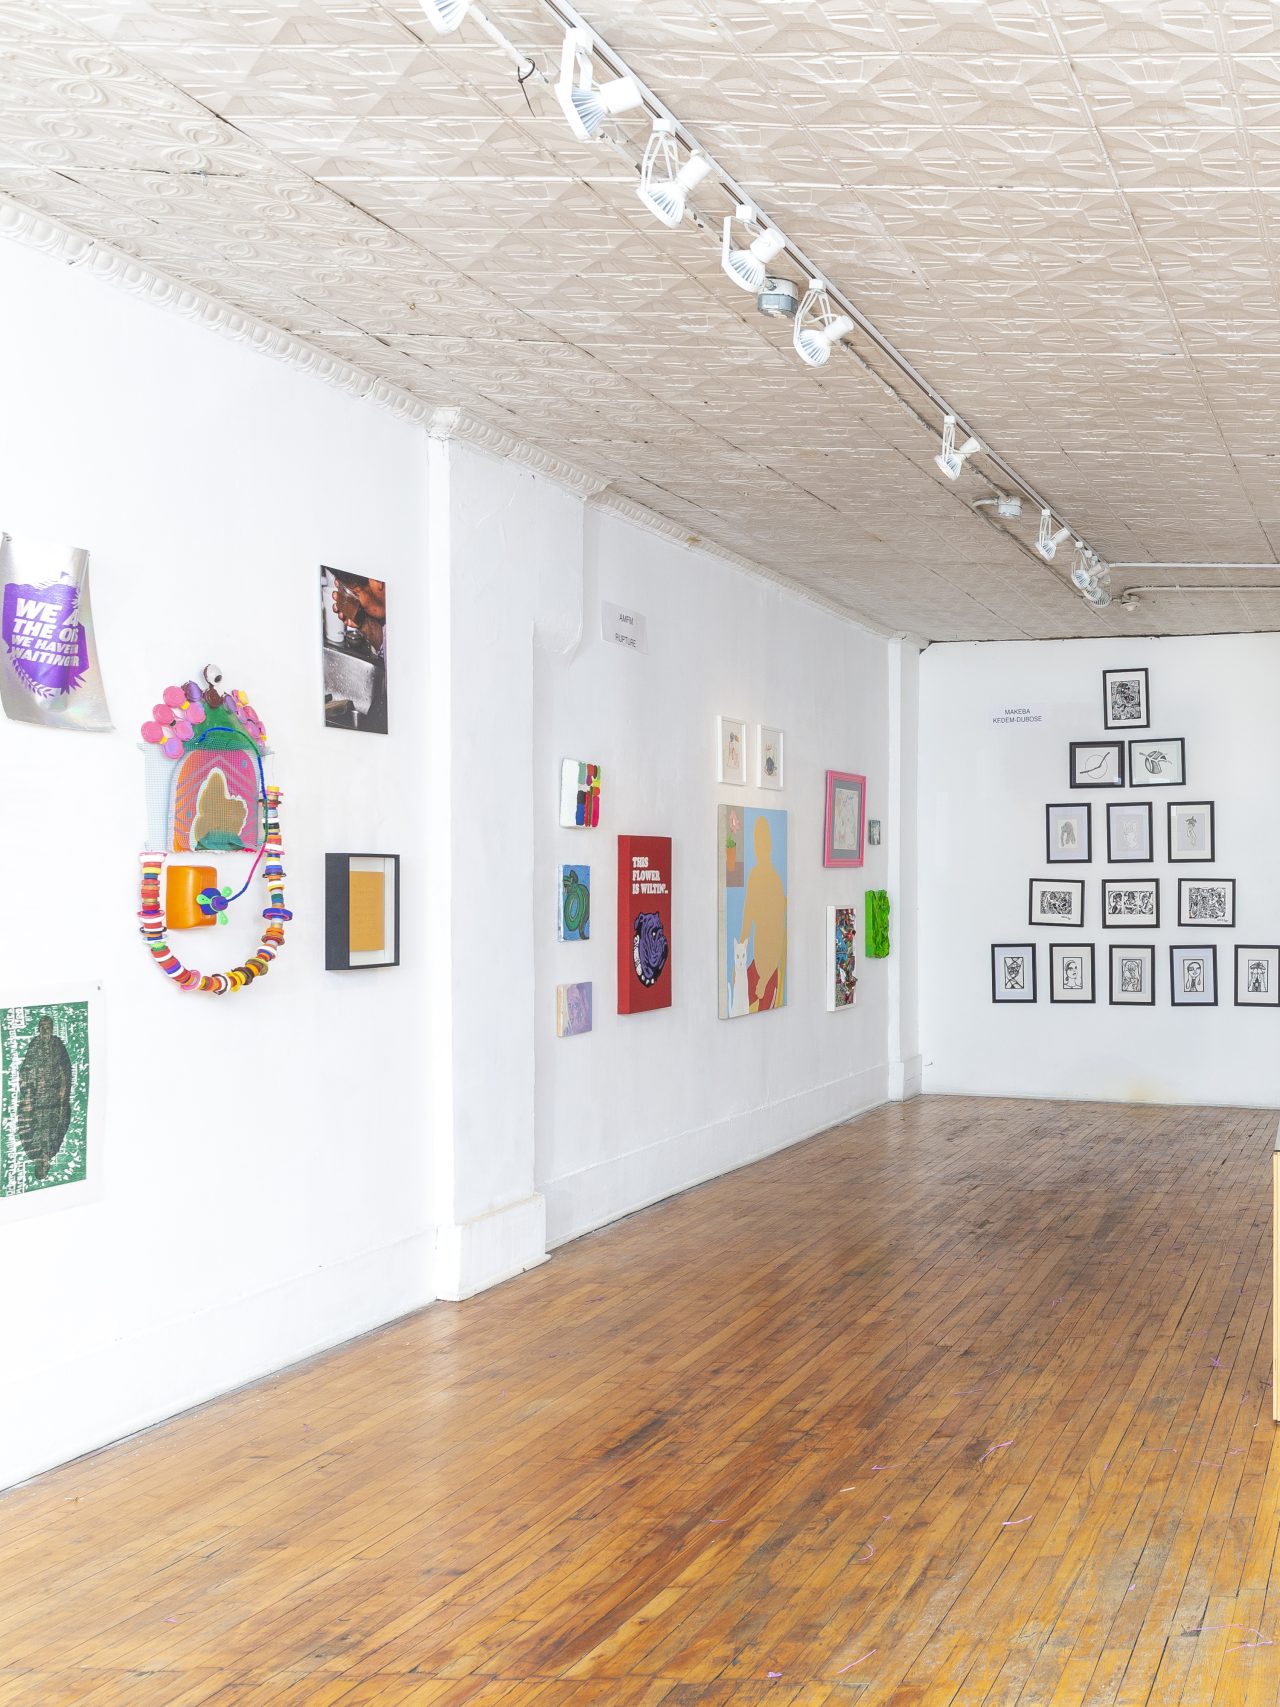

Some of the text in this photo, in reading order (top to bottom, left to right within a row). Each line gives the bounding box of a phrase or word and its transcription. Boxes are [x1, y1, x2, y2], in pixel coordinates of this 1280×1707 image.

[16, 597, 63, 624] WE
[12, 617, 58, 640] THE
[11, 633, 34, 647] WE
[632, 856, 649, 868] THIS
[632, 870, 661, 882] FLOWER
[632, 883, 640, 895] IS
